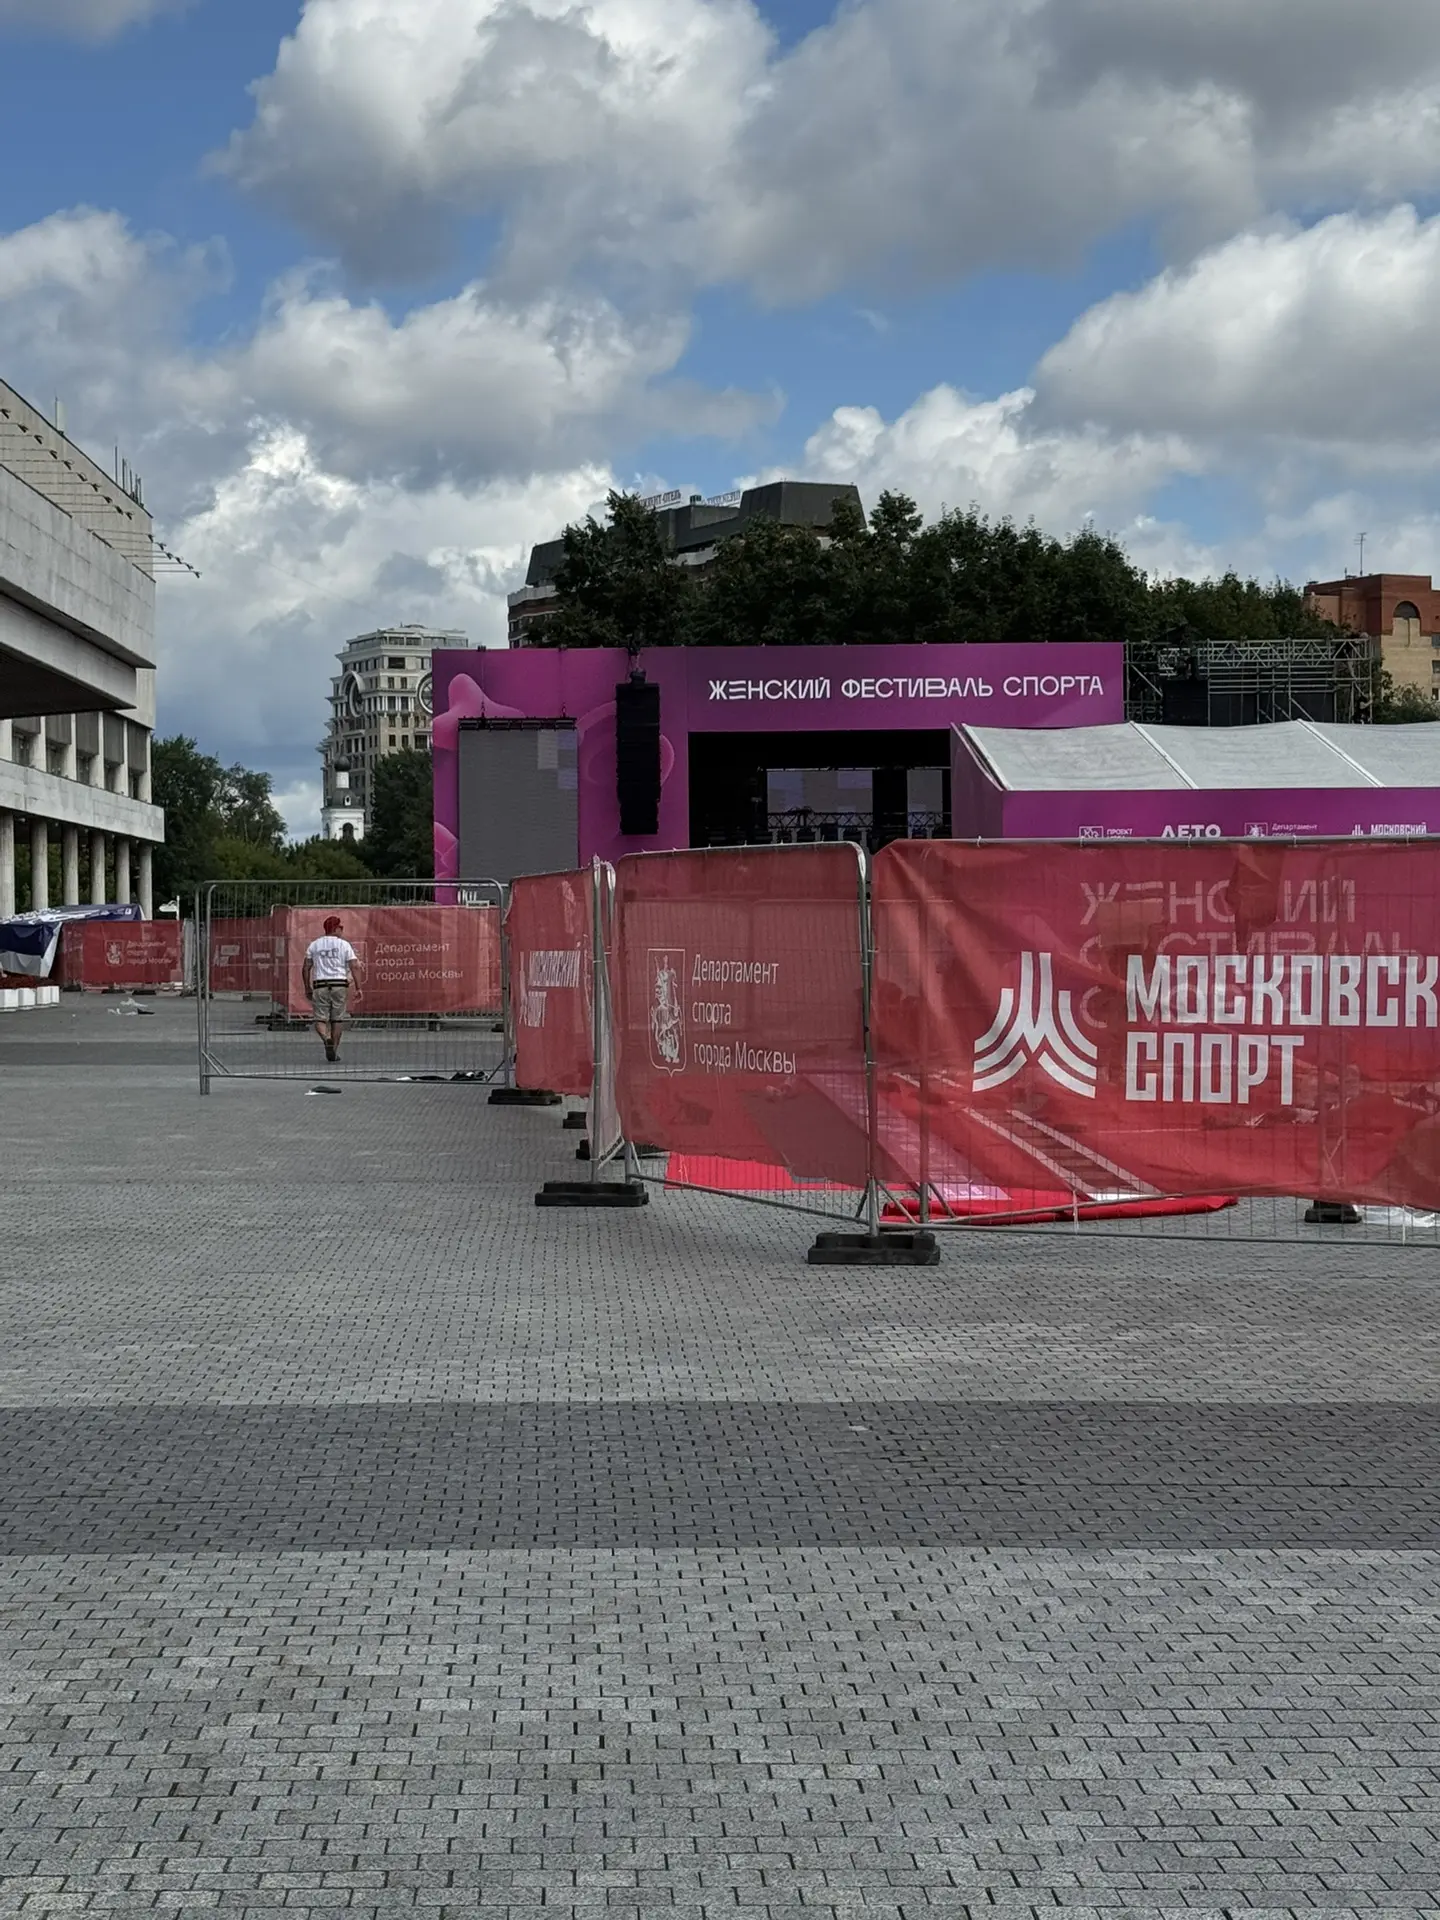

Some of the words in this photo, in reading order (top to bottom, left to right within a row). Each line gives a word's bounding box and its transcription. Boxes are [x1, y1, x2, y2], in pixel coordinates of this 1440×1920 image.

[708, 677, 831, 700] ЖЕНСКИЙ
[841, 678, 993, 698] ФЕСТИВАЛЬ
[1003, 675, 1104, 697] СПОРТА
[375, 943, 450, 954] Департамент
[375, 957, 415, 967] спорта
[375, 971, 416, 982] города
[418, 968, 464, 980] Москвы
[691, 953, 780, 991] Департамент
[1126, 954, 1440, 1028] МОСКОВСК
[691, 1001, 733, 1032] спорта
[693, 1042, 731, 1074] города
[734, 1040, 797, 1075] Москвы
[1125, 1031, 1304, 1106] СПОРТ
